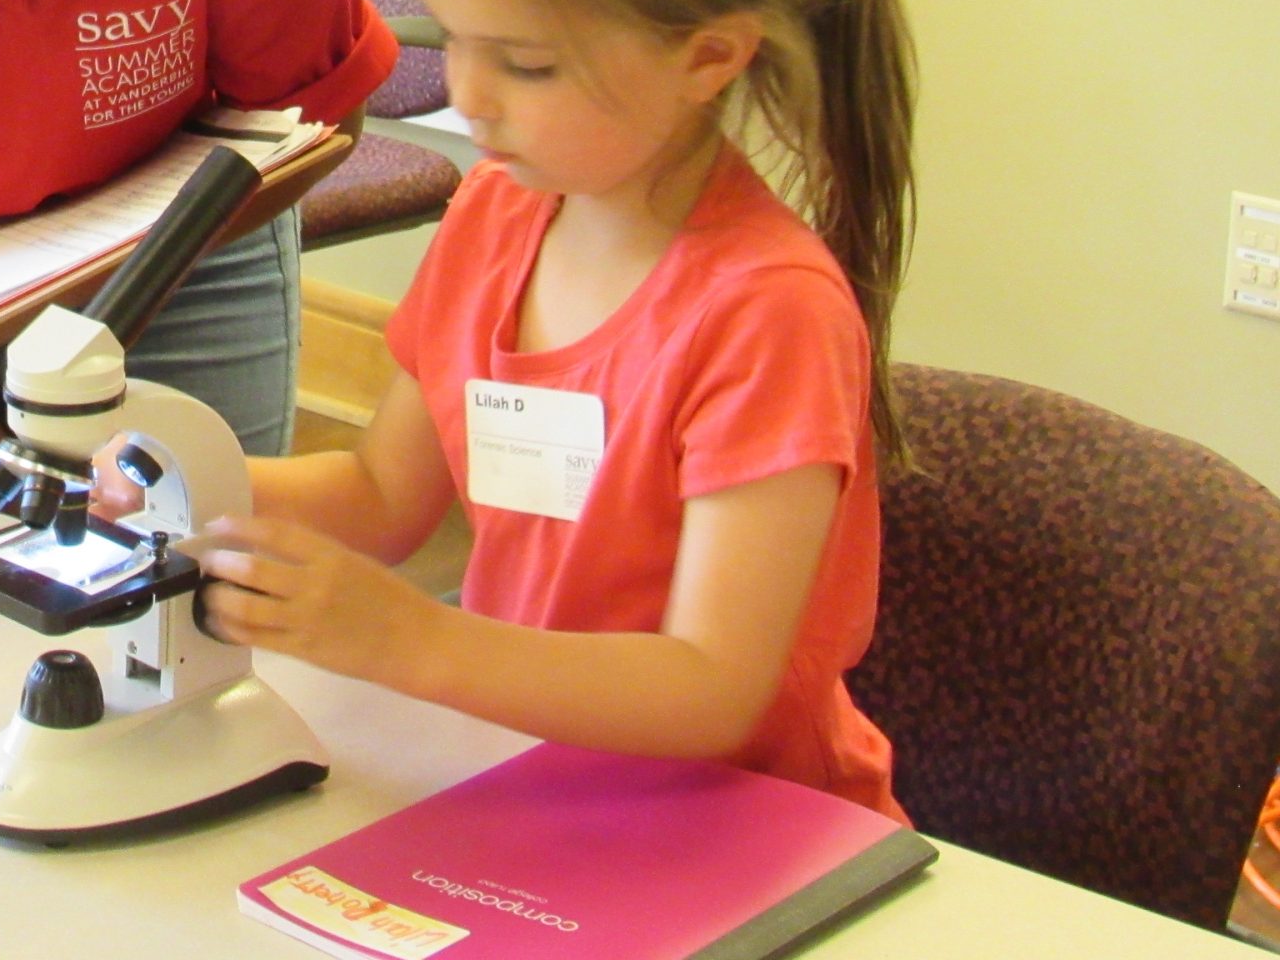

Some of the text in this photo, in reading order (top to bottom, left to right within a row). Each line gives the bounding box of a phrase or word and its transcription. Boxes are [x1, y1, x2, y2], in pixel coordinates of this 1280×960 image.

[79, 28, 196, 78] SUMMER
[81, 43, 195, 97] ACADEMY
[83, 62, 195, 112] AT VANDERBILT
[84, 74, 195, 126] FOR THE YOUNG
[475, 393, 526, 413] Lilah D
[411, 869, 580, 933] composition
